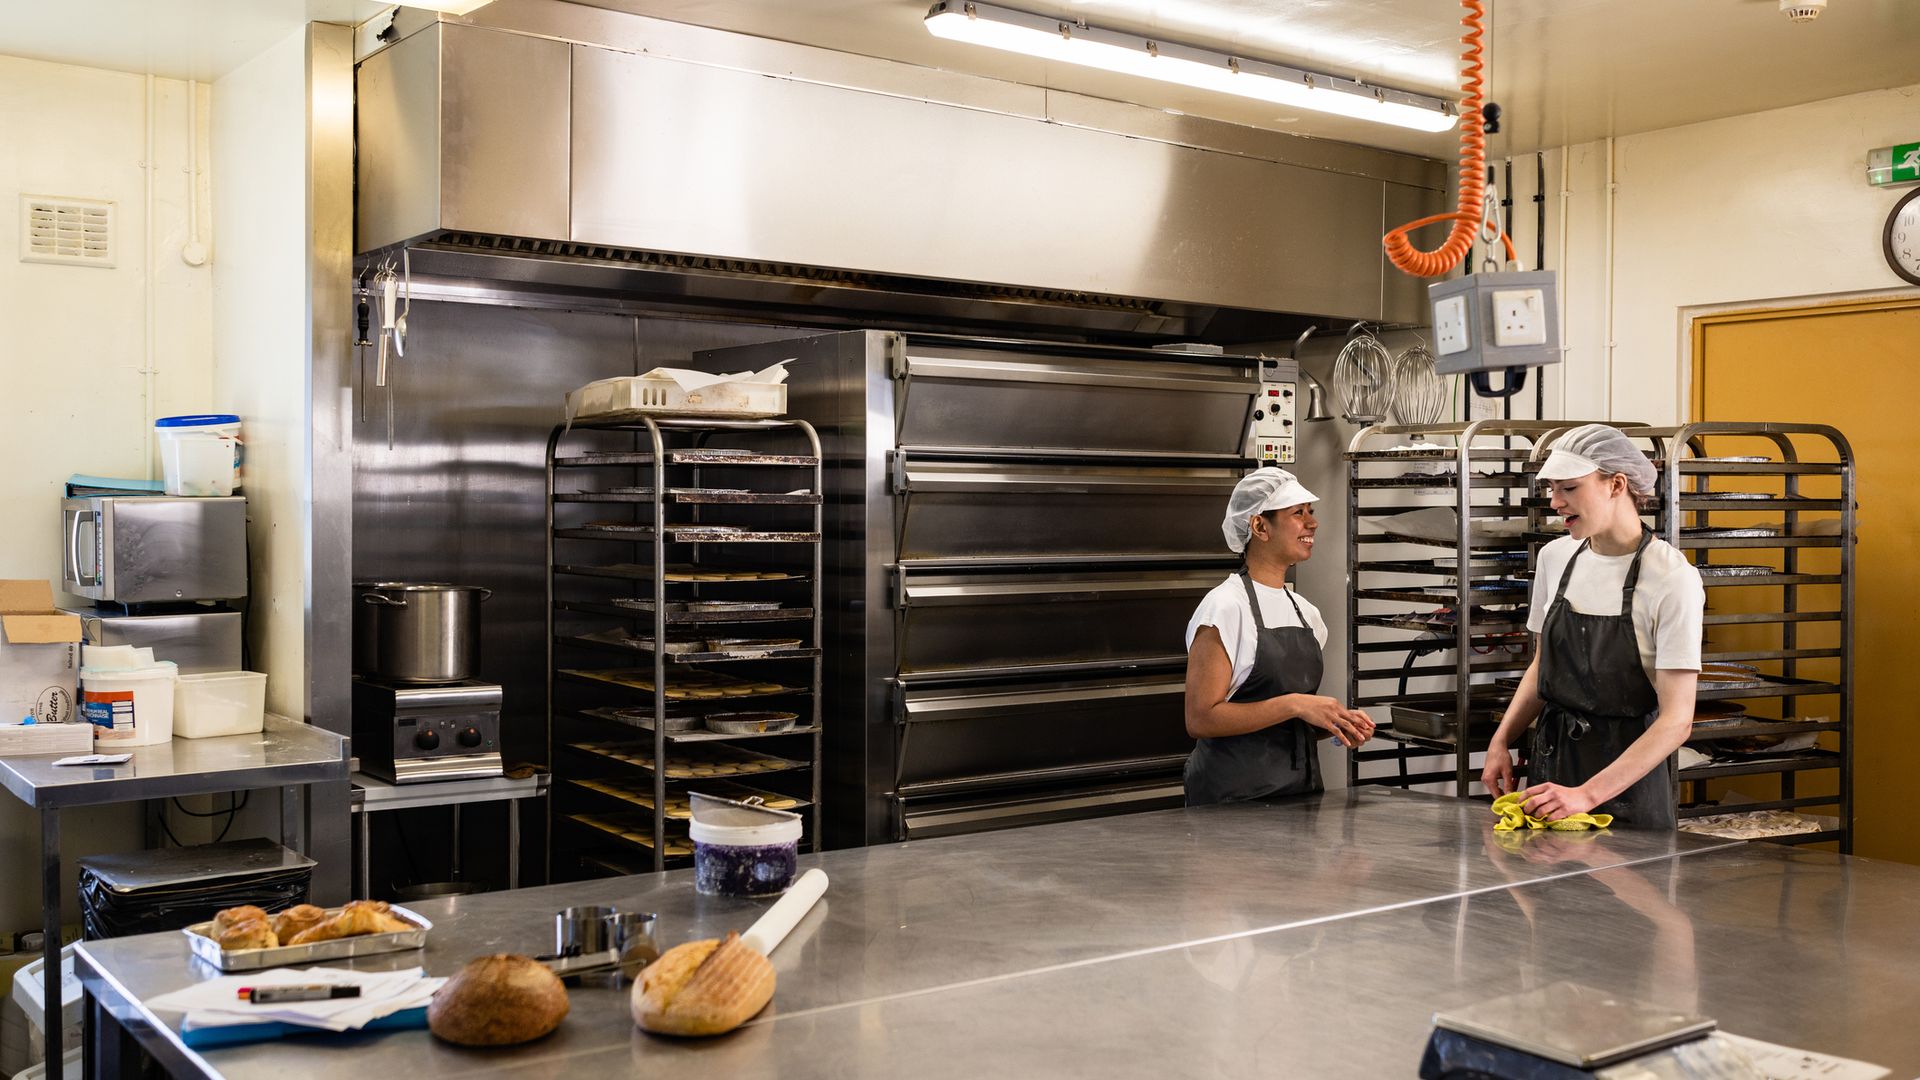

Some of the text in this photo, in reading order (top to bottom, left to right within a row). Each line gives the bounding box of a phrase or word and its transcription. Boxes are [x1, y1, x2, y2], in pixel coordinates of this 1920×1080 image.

[1904, 215, 1915, 227] 10
[1897, 231, 1906, 243] 9
[1902, 247, 1912, 260] 8
[45, 690, 59, 722] Butter
